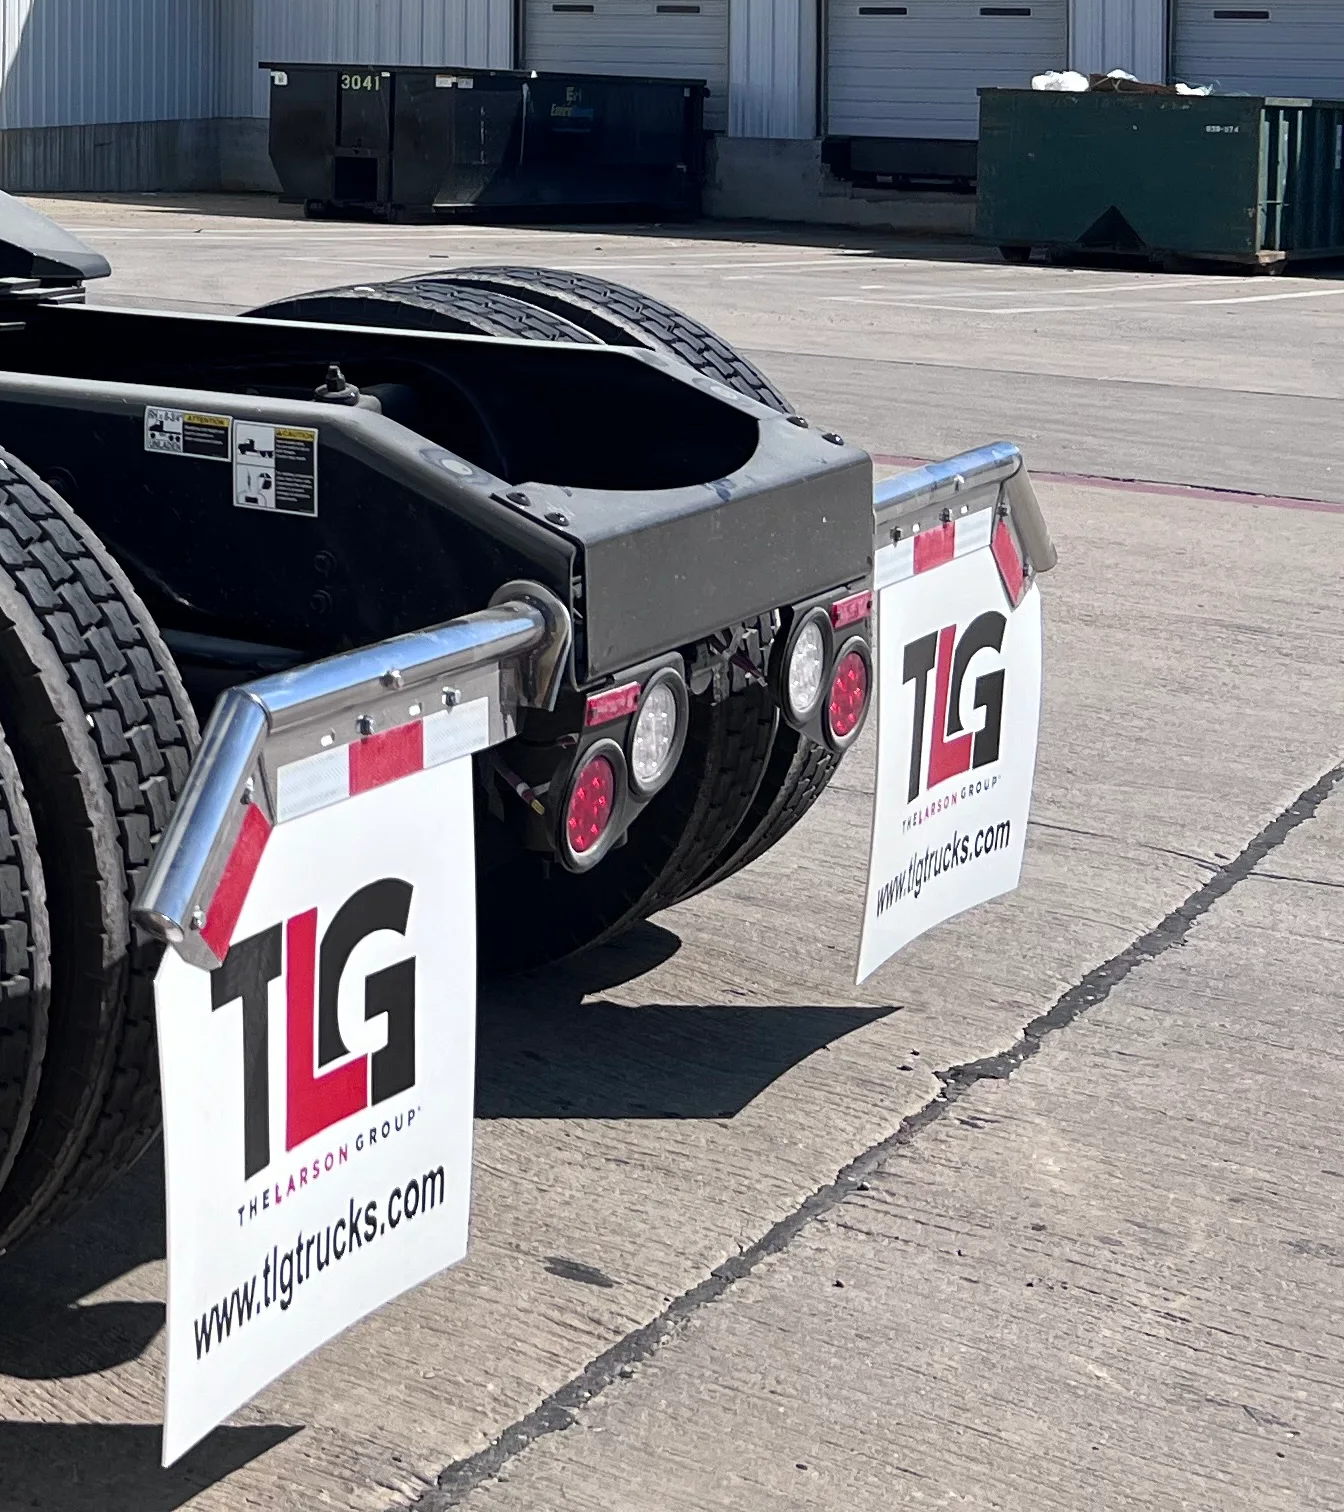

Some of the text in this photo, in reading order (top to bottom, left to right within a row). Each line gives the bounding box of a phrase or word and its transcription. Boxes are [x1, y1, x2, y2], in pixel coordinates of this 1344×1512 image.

[341, 75, 380, 91] 3041
[902, 610, 1008, 805] TLG
[961, 776, 998, 799] GROUP
[876, 819, 1011, 918] www.tlgtrucks.com
[211, 877, 416, 1181] TLG
[355, 1109, 416, 1151] GROUP
[193, 1164, 445, 1360] www.tlgtrucks.com
